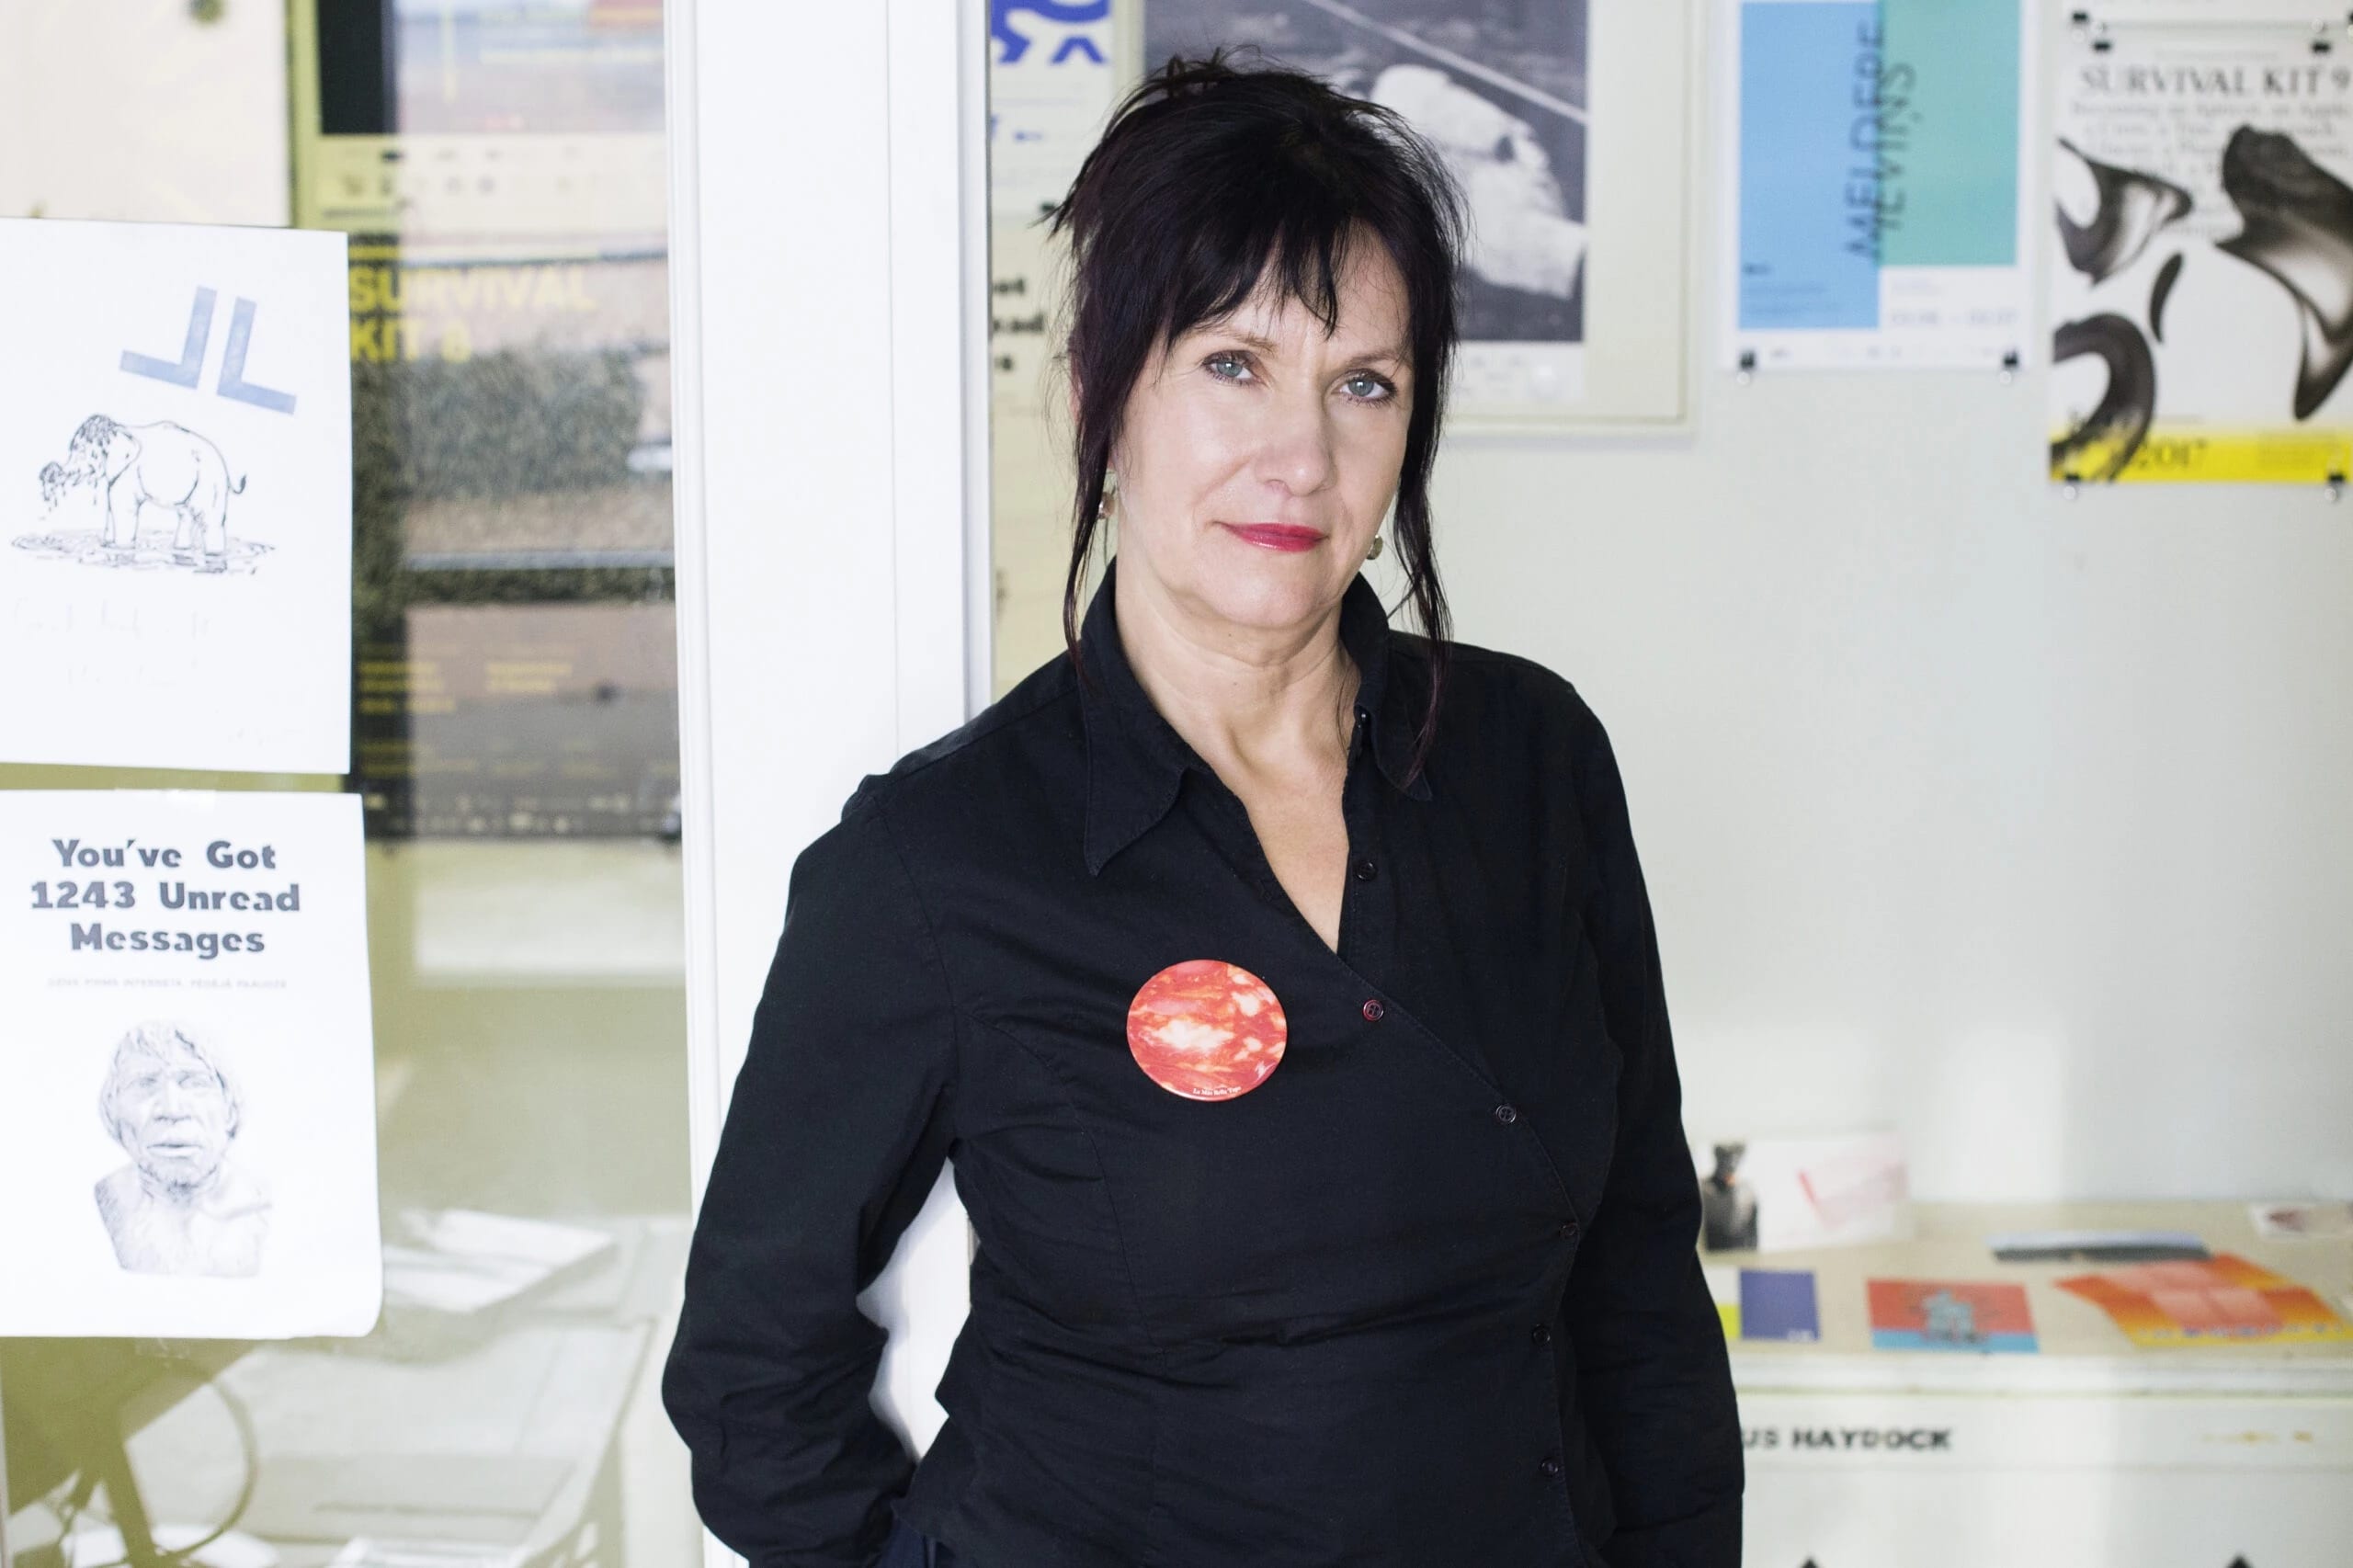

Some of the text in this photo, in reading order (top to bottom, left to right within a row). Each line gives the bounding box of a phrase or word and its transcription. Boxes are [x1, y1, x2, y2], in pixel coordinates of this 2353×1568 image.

[2080, 65, 2249, 95] SURVIVAL
[2262, 65, 2323, 96] KIT
[52, 838, 276, 870] You've Got
[31, 881, 301, 913] 1243 Unread
[71, 923, 266, 960] Messages
[1791, 1427, 1952, 1449] HAYDOCK
